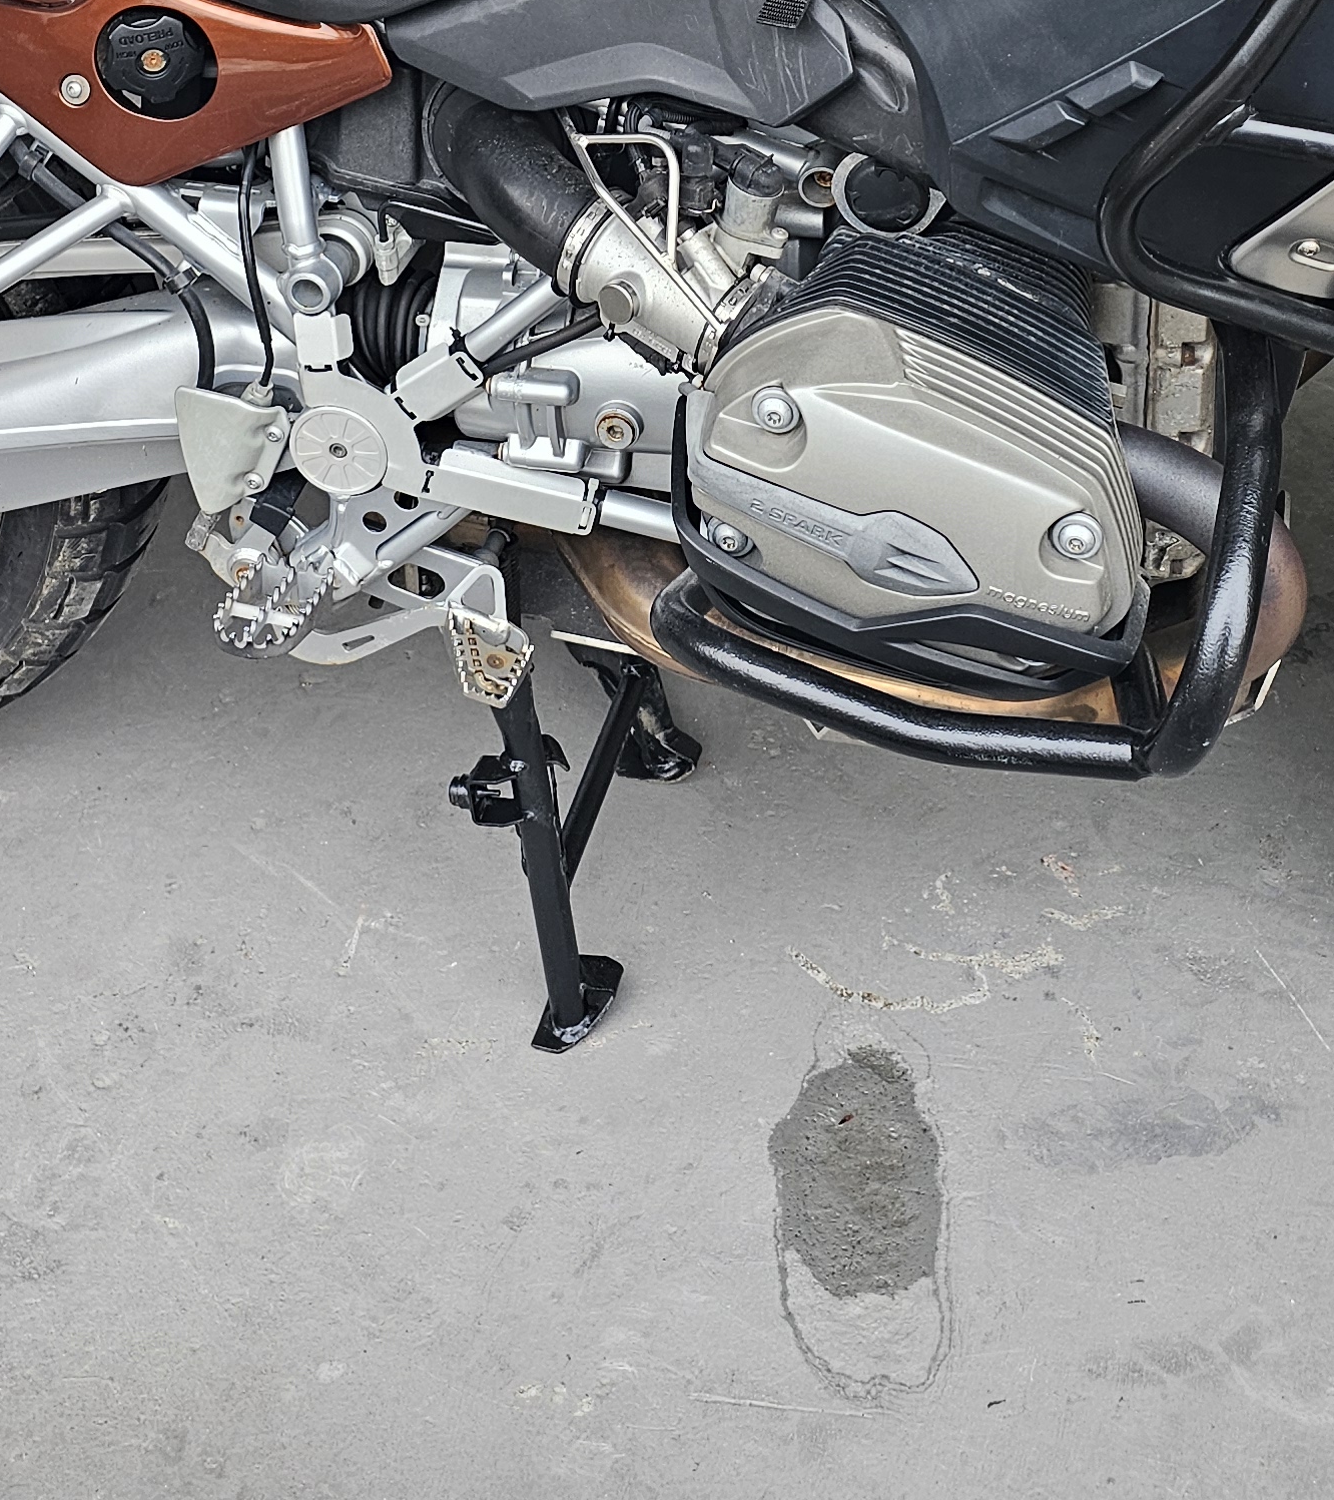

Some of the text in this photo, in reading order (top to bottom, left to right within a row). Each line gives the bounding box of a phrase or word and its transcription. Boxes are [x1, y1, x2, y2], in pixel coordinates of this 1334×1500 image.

[749, 498, 844, 547] 2 SPARK
[986, 585, 1091, 623] magnesium
